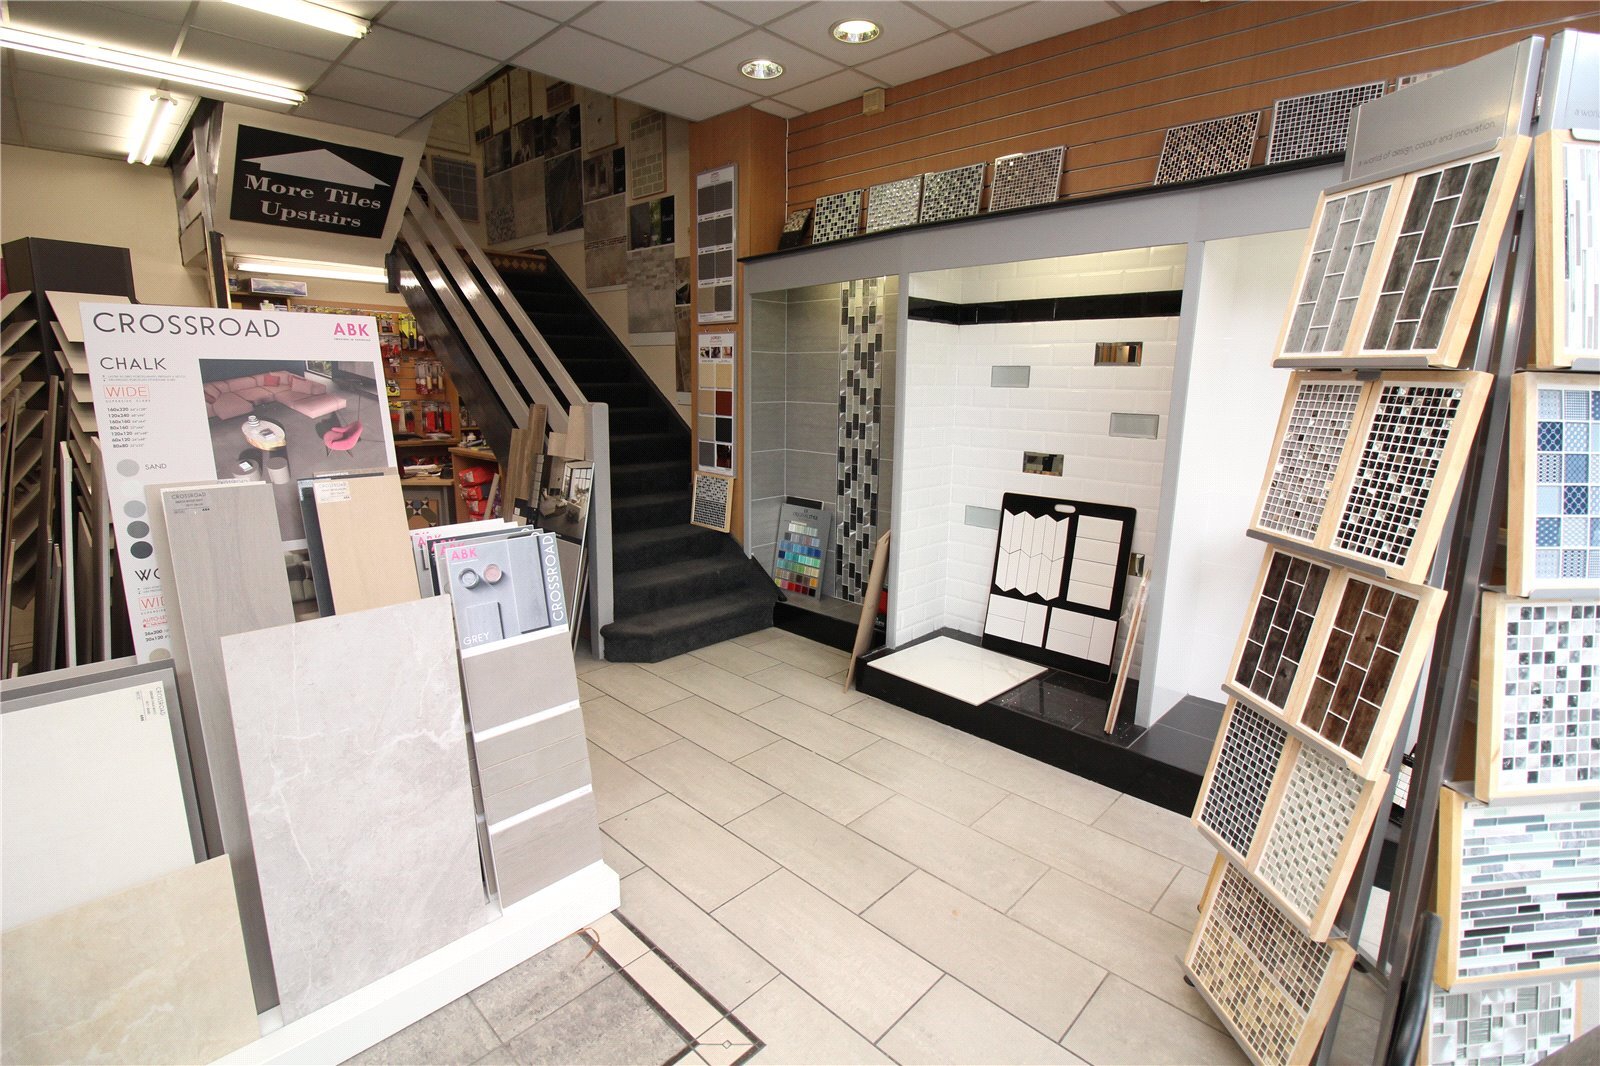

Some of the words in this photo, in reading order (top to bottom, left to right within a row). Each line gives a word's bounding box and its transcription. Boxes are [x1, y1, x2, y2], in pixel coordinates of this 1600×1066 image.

[244, 174, 314, 199] More
[324, 188, 381, 210] Tiles
[260, 200, 361, 228] Upstairs
[93, 312, 280, 338] CROSSROAD
[334, 322, 370, 336] ABK
[100, 357, 167, 370] CHALK
[106, 386, 148, 397] WIDE
[451, 548, 477, 561] ABK
[542, 535, 564, 621] CROSSROAD
[463, 631, 490, 646] GREY
